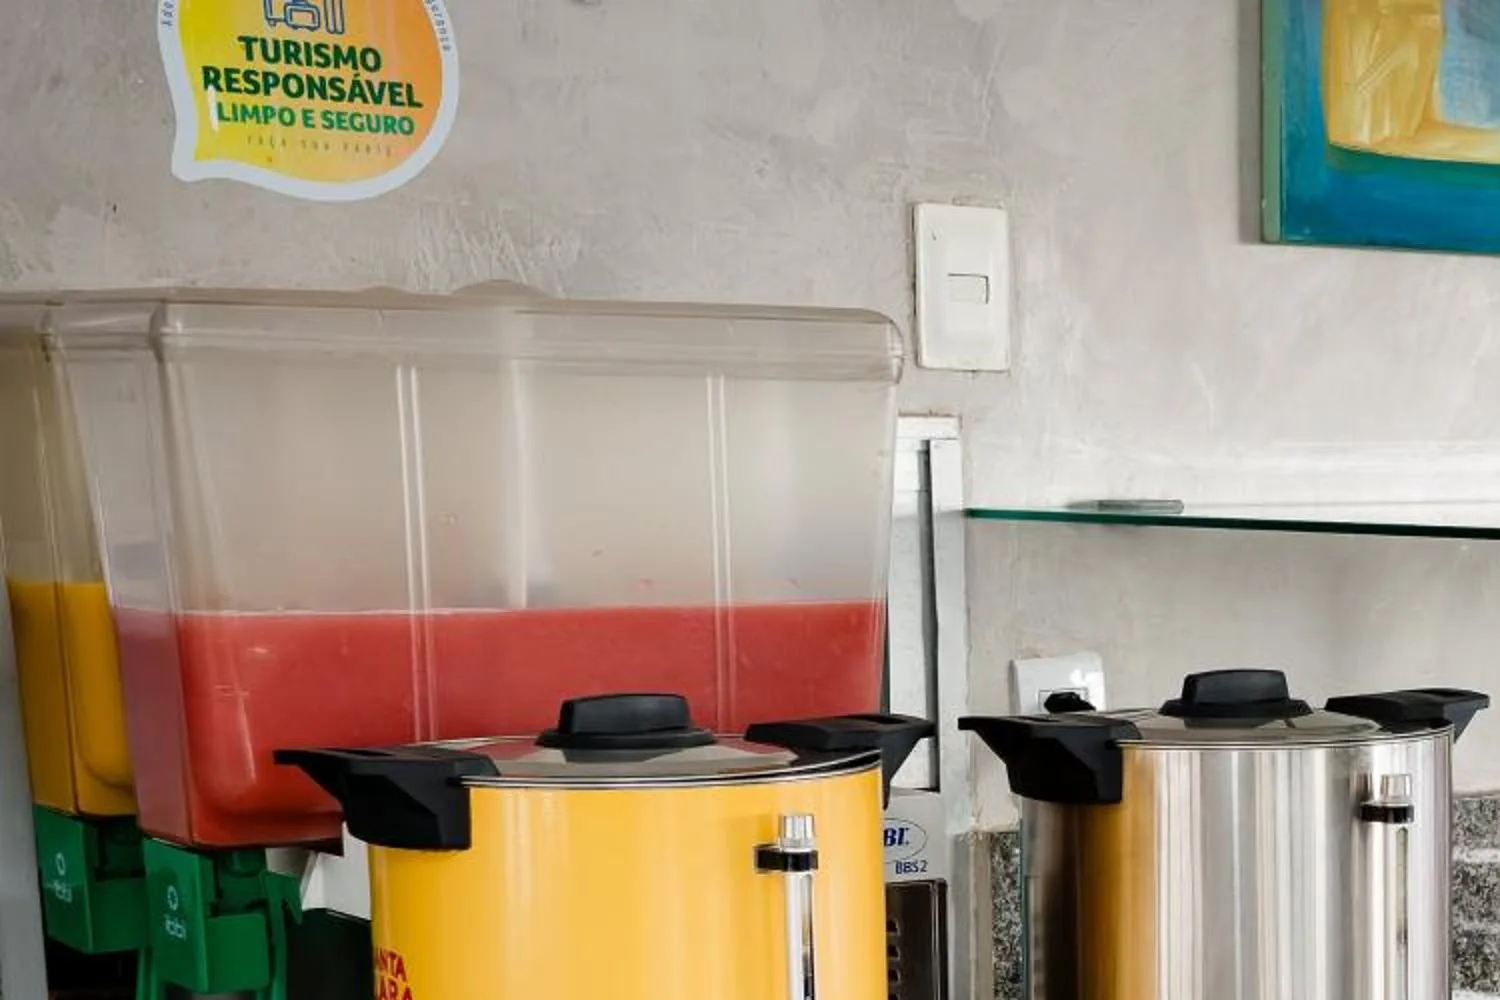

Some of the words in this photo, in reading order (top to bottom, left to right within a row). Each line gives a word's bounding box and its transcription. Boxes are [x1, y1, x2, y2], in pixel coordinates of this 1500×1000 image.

[238, 35, 383, 73] TURISMO
[201, 65, 424, 108] RESPONSÁVEL
[215, 101, 296, 128] LIMPO
[302, 108, 316, 129] E
[321, 109, 415, 136] SEGURO
[375, 946, 408, 982] NTA
